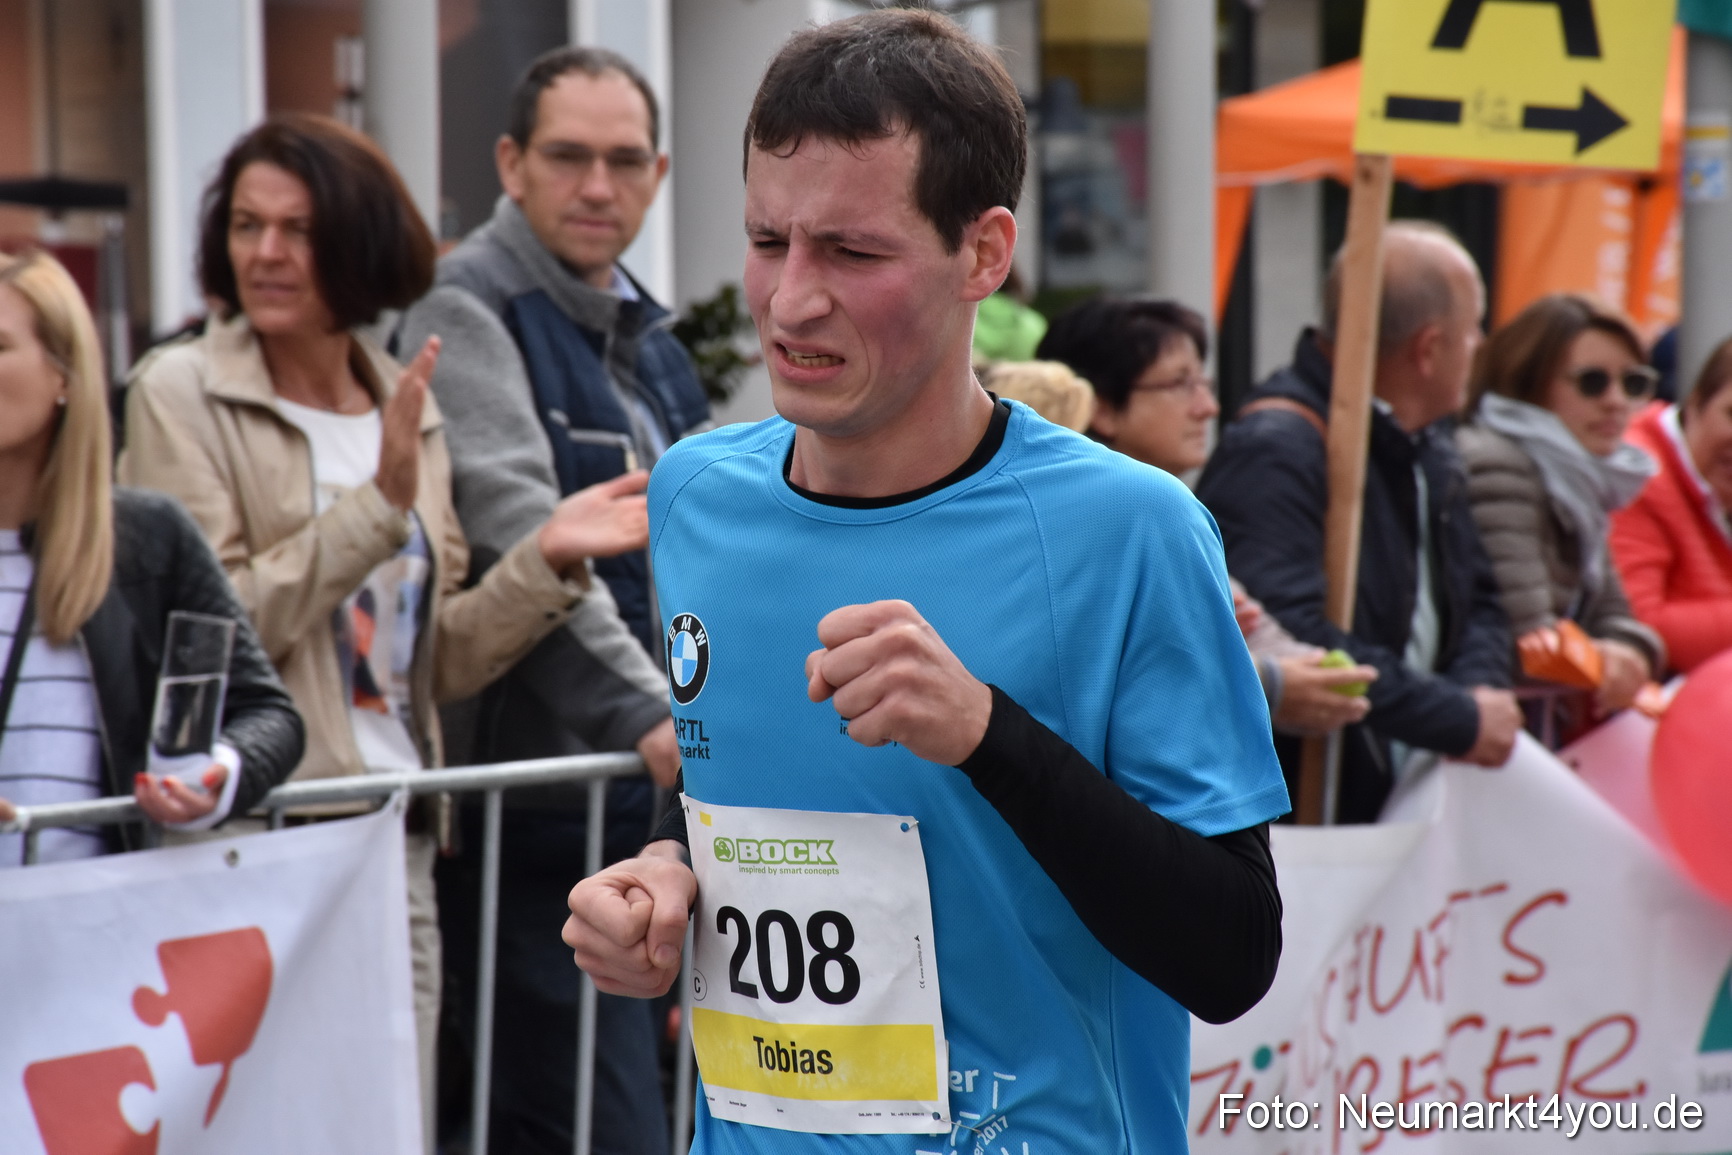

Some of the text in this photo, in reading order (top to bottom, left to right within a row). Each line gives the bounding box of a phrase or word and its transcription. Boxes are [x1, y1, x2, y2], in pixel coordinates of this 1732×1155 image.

[668, 615, 707, 647] BMW
[736, 838, 838, 865] BOCK
[739, 865, 840, 876] inspired by smart concepts
[716, 905, 861, 1005] 208
[753, 1035, 834, 1075] Tobias
[978, 1115, 1008, 1146] 2017
